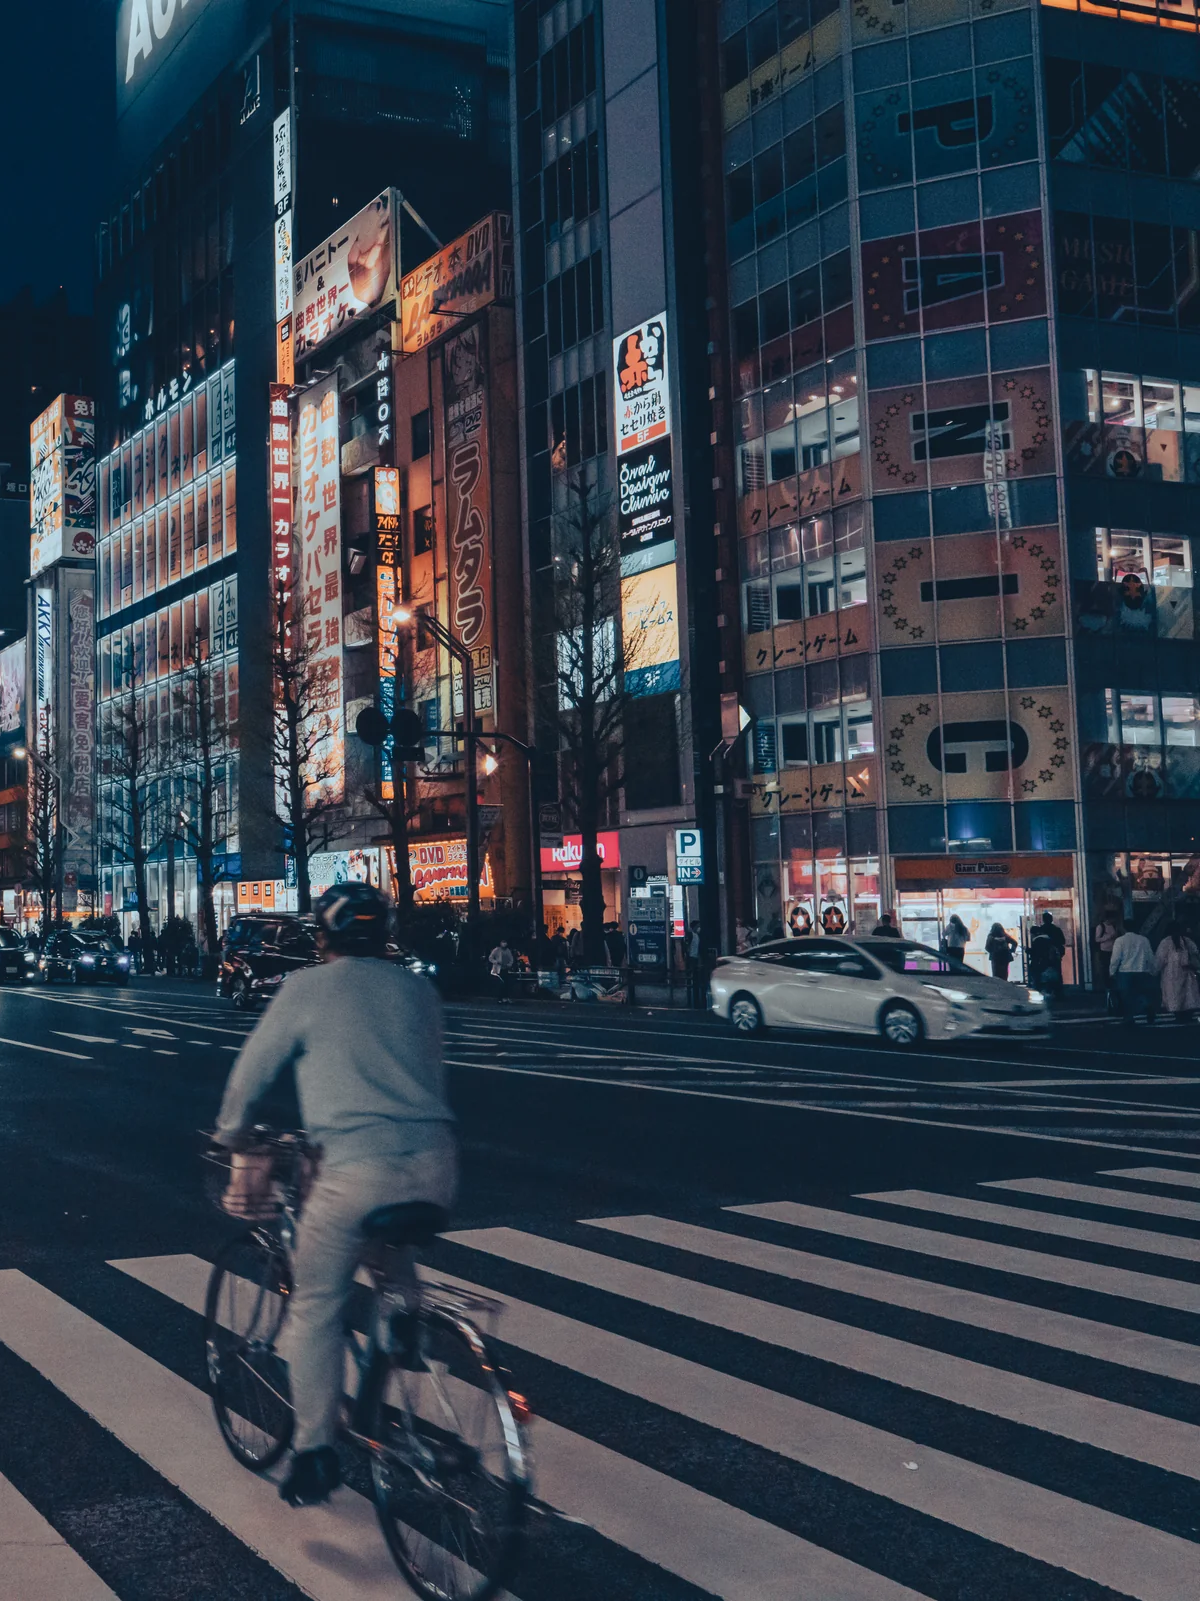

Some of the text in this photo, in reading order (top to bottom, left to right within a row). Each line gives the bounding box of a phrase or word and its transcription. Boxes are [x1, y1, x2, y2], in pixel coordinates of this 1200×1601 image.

[277, 197, 289, 215] 8F
[466, 222, 490, 261] DVD
[304, 235, 349, 283] ハニトー
[317, 276, 325, 291] &
[295, 283, 349, 334] 曲数世界一
[295, 302, 349, 358] カラオケ
[624, 391, 661, 419] 赤から鍋
[620, 405, 666, 436] セセリ焼き
[620, 456, 655, 484] Oral
[620, 467, 670, 499] Design
[620, 488, 669, 515] Clinic
[750, 477, 854, 523] クレーンゲーム
[321, 390, 341, 648] 曲数世界最強
[450, 441, 488, 646] ラムタラ
[38, 594, 51, 648] AKKY
[756, 628, 859, 665] クレーンゲーム
[761, 780, 866, 809] クレーンゲーム
[419, 845, 445, 866] DVD
[552, 841, 605, 862] Rakun
[680, 832, 697, 854] P
[677, 867, 691, 878] IN
[977, 862, 1000, 873] PANIC
